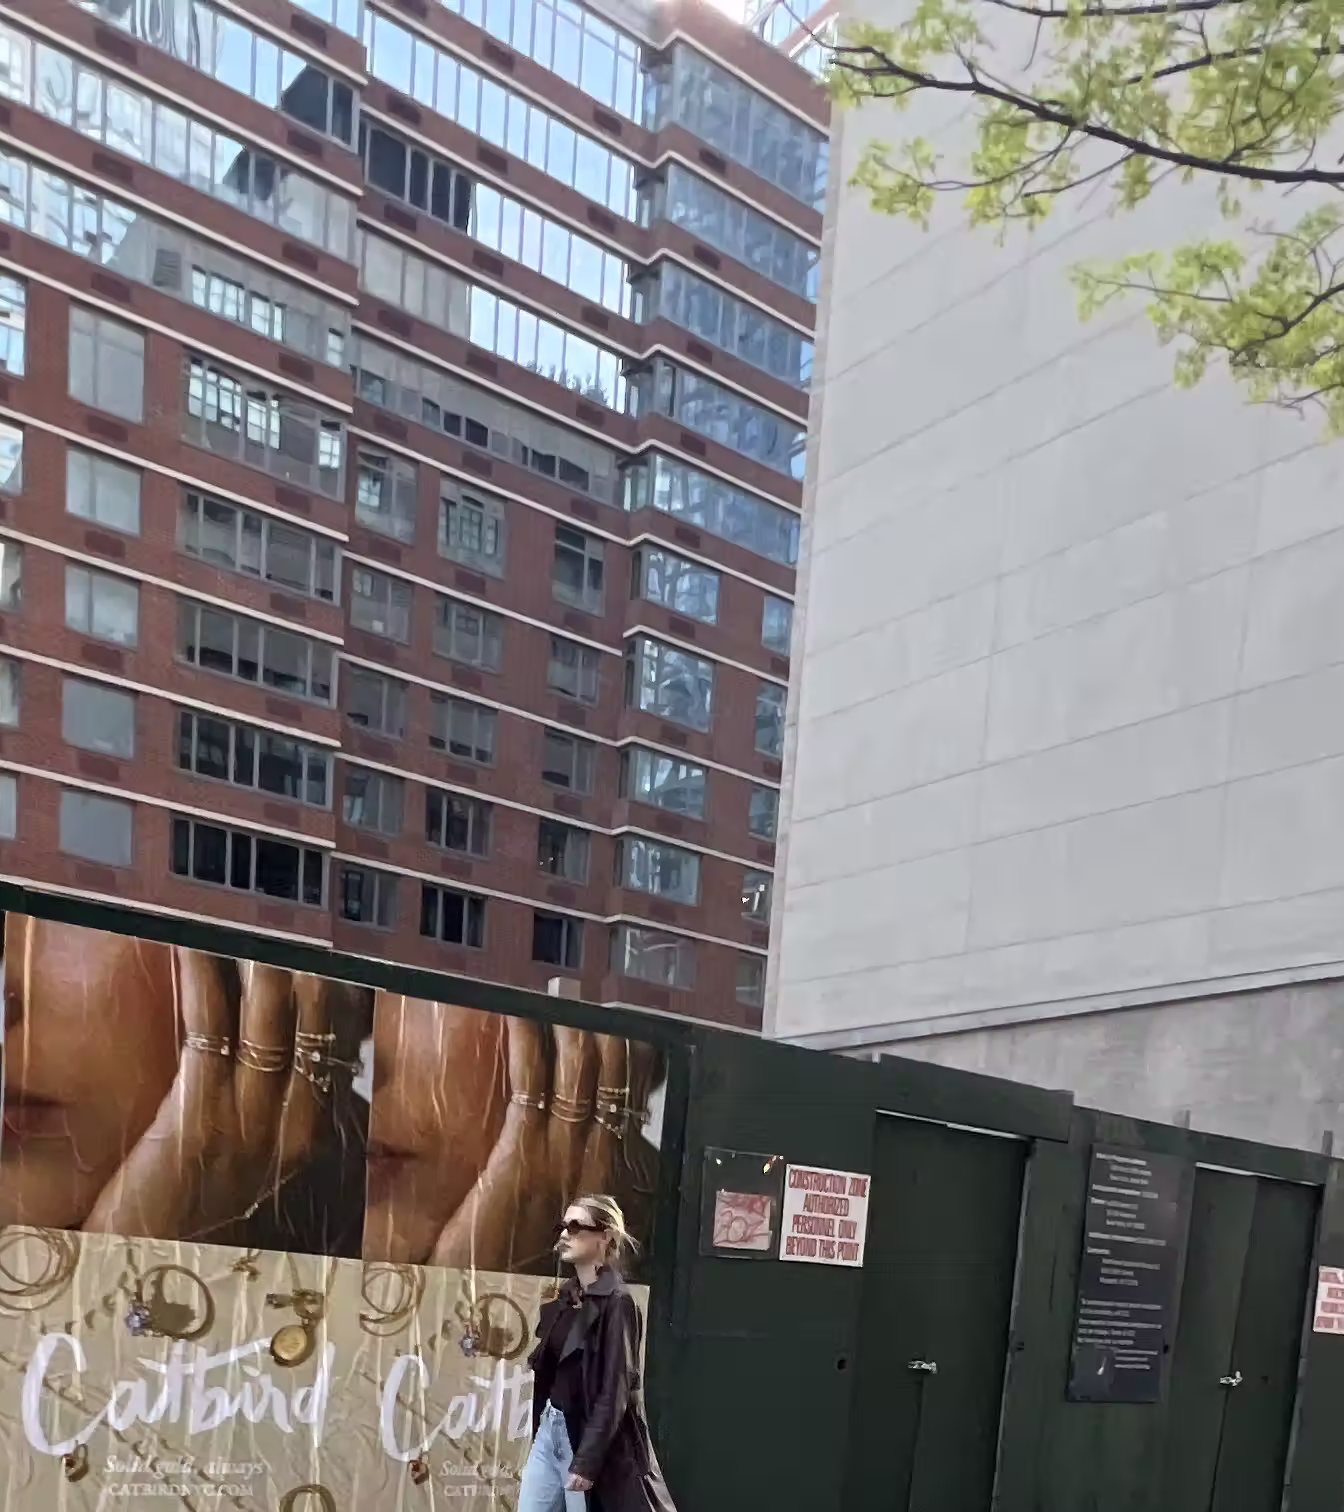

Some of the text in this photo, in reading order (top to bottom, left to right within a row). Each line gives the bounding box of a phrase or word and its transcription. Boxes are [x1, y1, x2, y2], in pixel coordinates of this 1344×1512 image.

[789, 1169, 867, 1197] CONSTRUCTION ZONE
[804, 1193, 849, 1216] AUTHORIZED
[793, 1215, 857, 1239] PERSONNEL ONLY
[786, 1236, 860, 1262] BEYOND THIS POINT
[22, 1333, 336, 1456] Catbird
[381, 1354, 535, 1462] Catb
[104, 1455, 152, 1474] Solid
[203, 1456, 265, 1481] always
